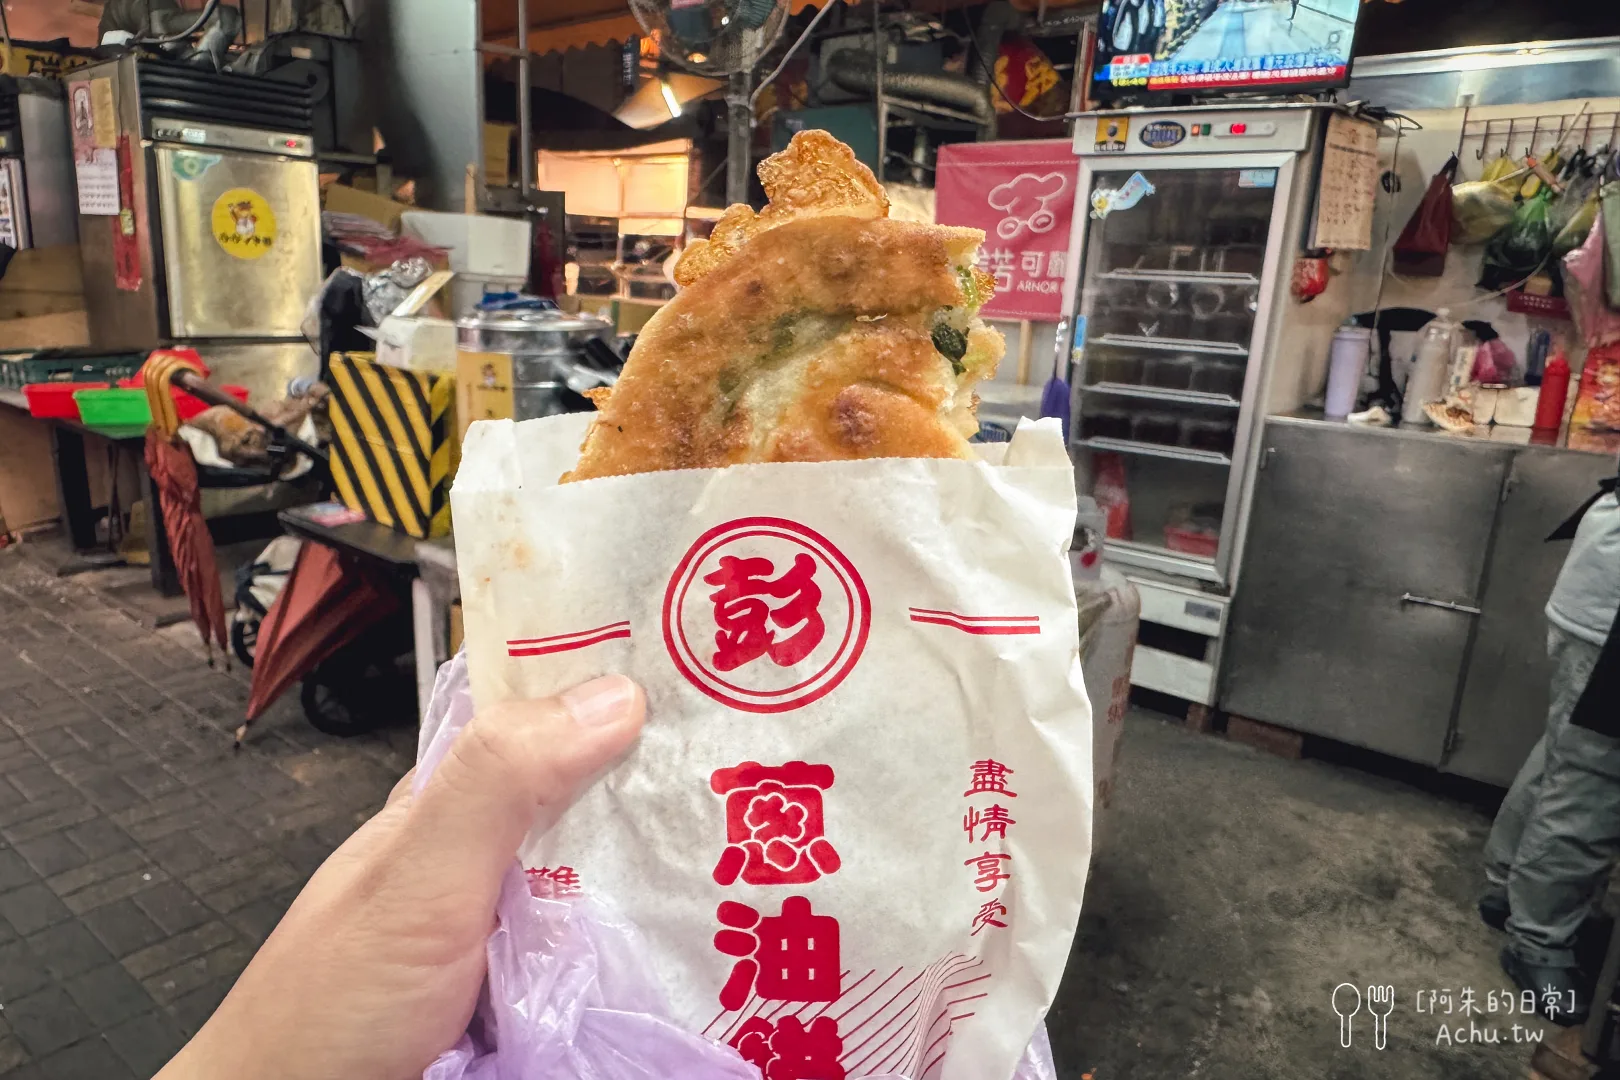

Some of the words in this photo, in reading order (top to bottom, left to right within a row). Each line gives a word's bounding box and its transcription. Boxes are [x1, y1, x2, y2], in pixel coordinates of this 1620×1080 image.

[703, 553, 825, 672] 彭
[963, 758, 1018, 937] 盡情享受
